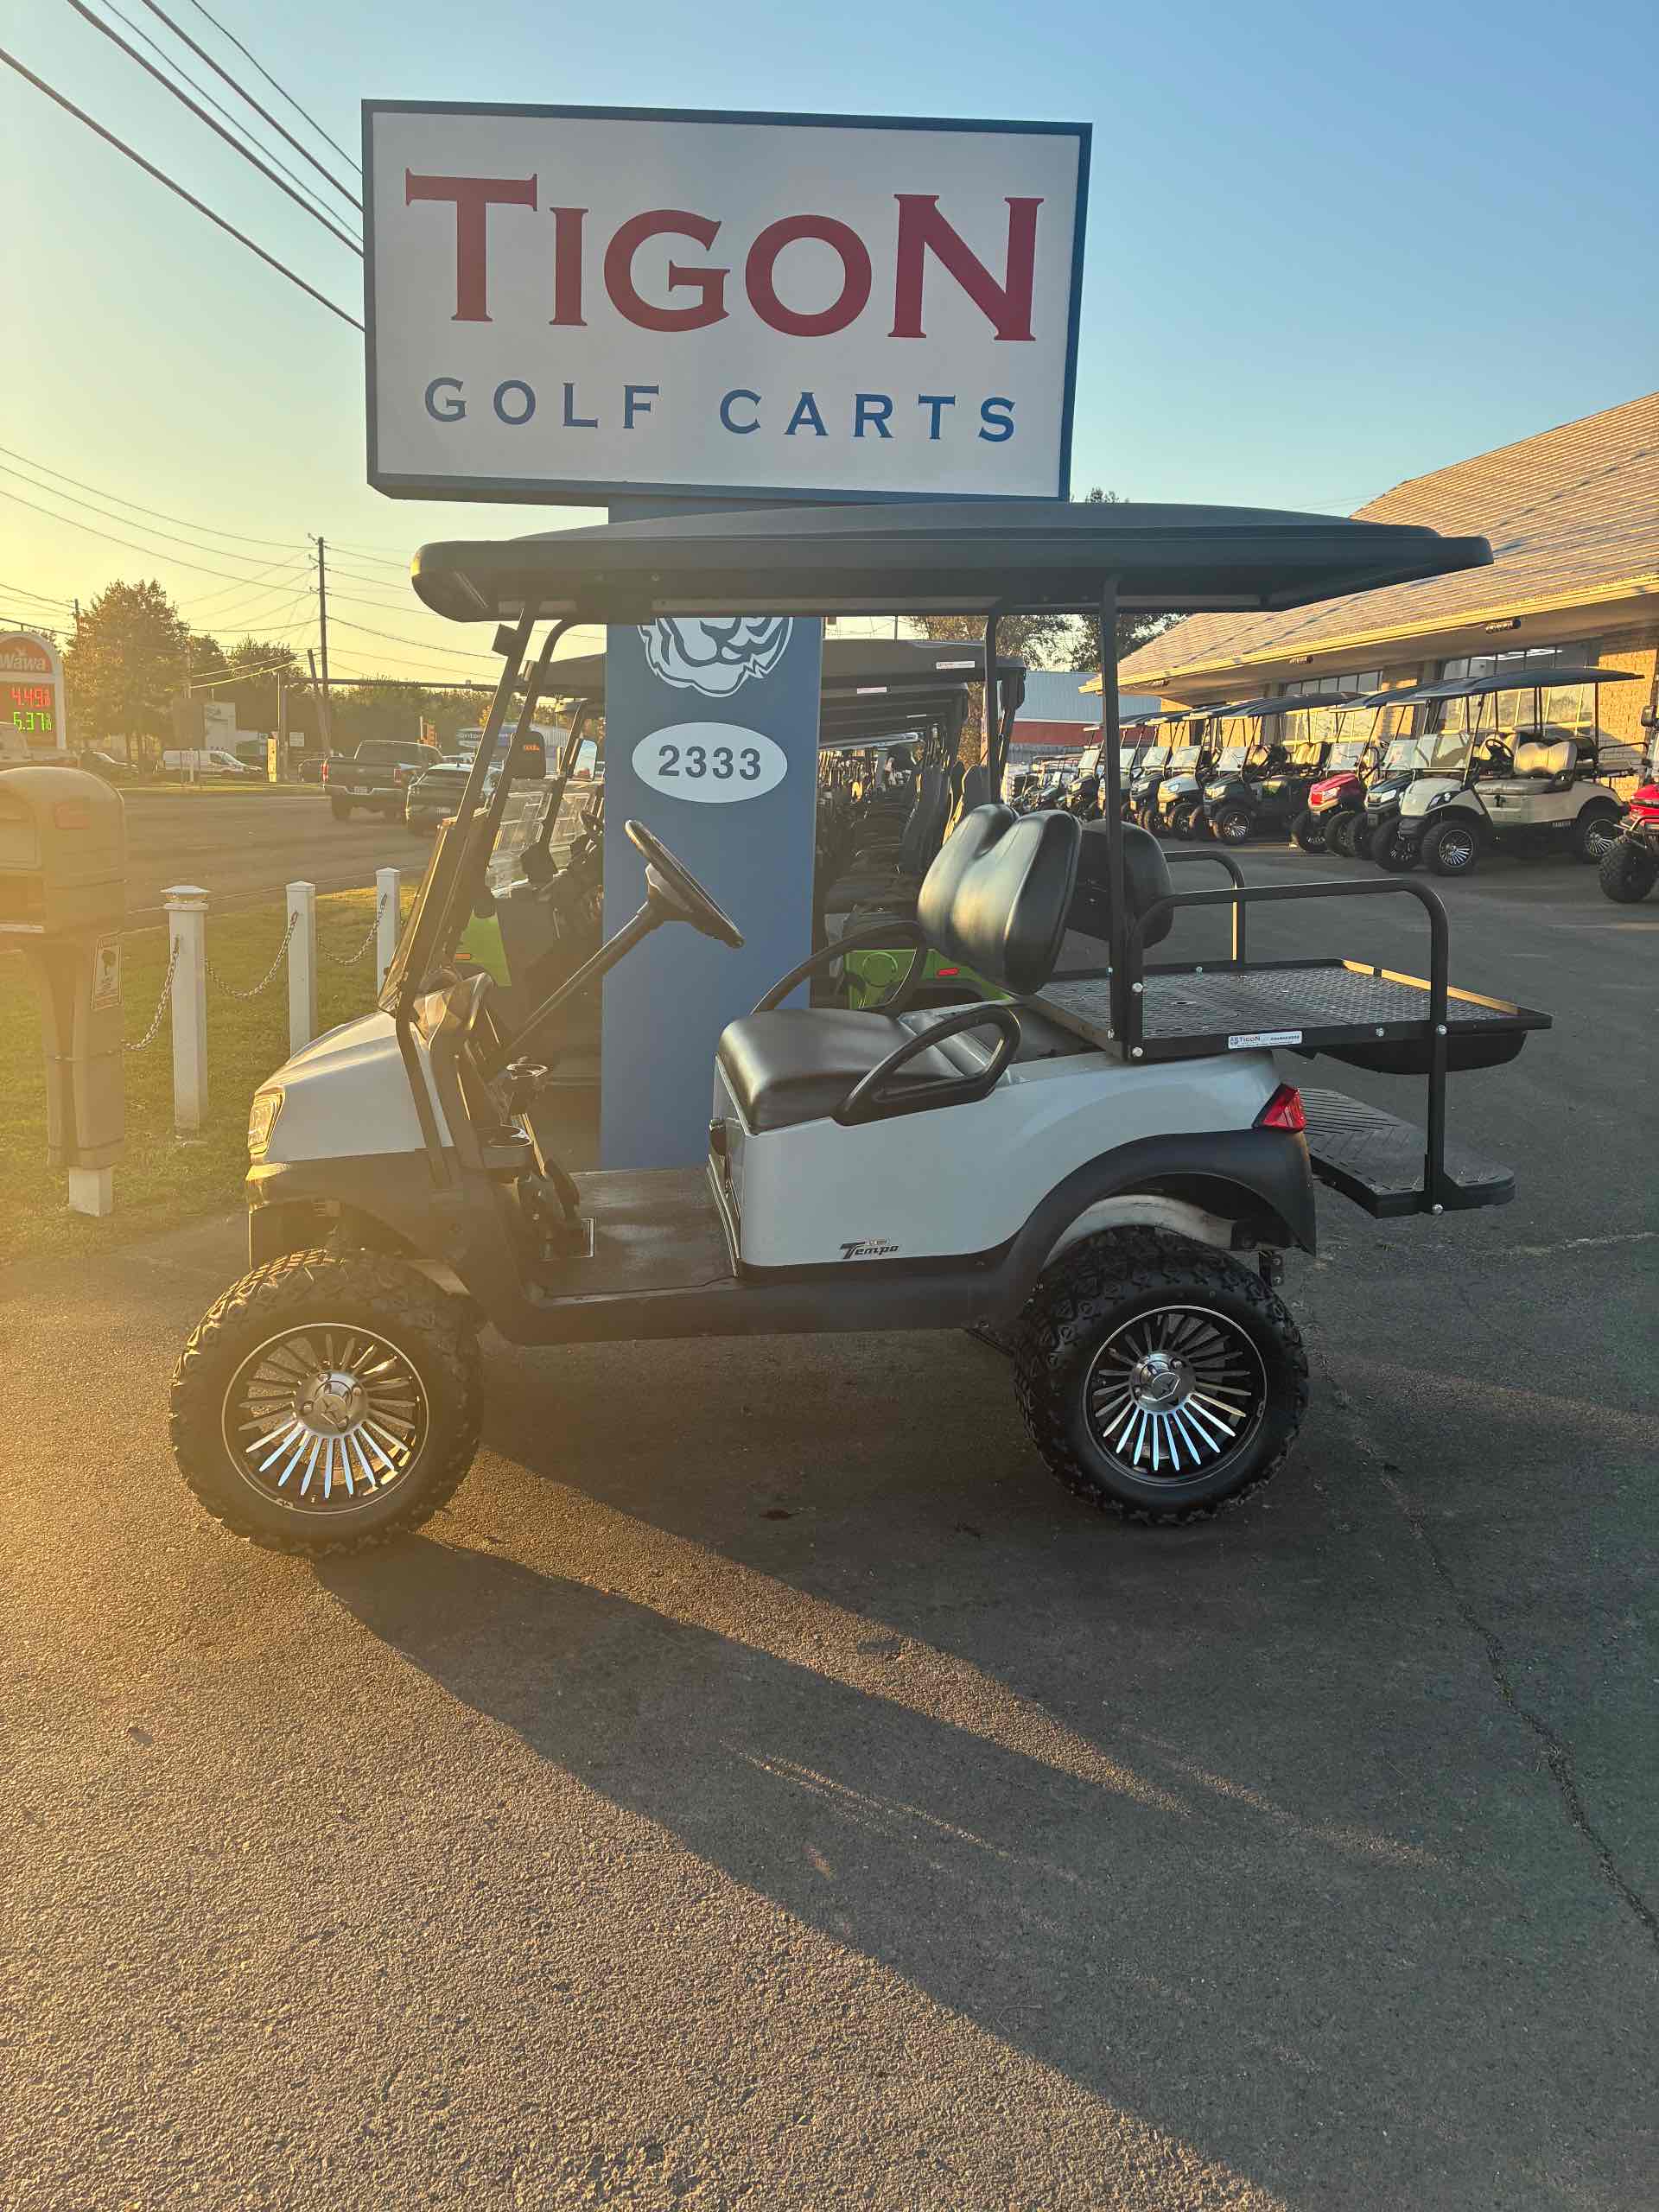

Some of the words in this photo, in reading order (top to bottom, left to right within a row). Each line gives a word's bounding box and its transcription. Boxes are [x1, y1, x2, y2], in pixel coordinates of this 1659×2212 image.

[405, 168, 1045, 342] TIGON
[424, 377, 660, 429] GOLF
[719, 389, 1016, 442] CARTS
[658, 744, 761, 781] 2333
[840, 1242, 899, 1260] Tempo
